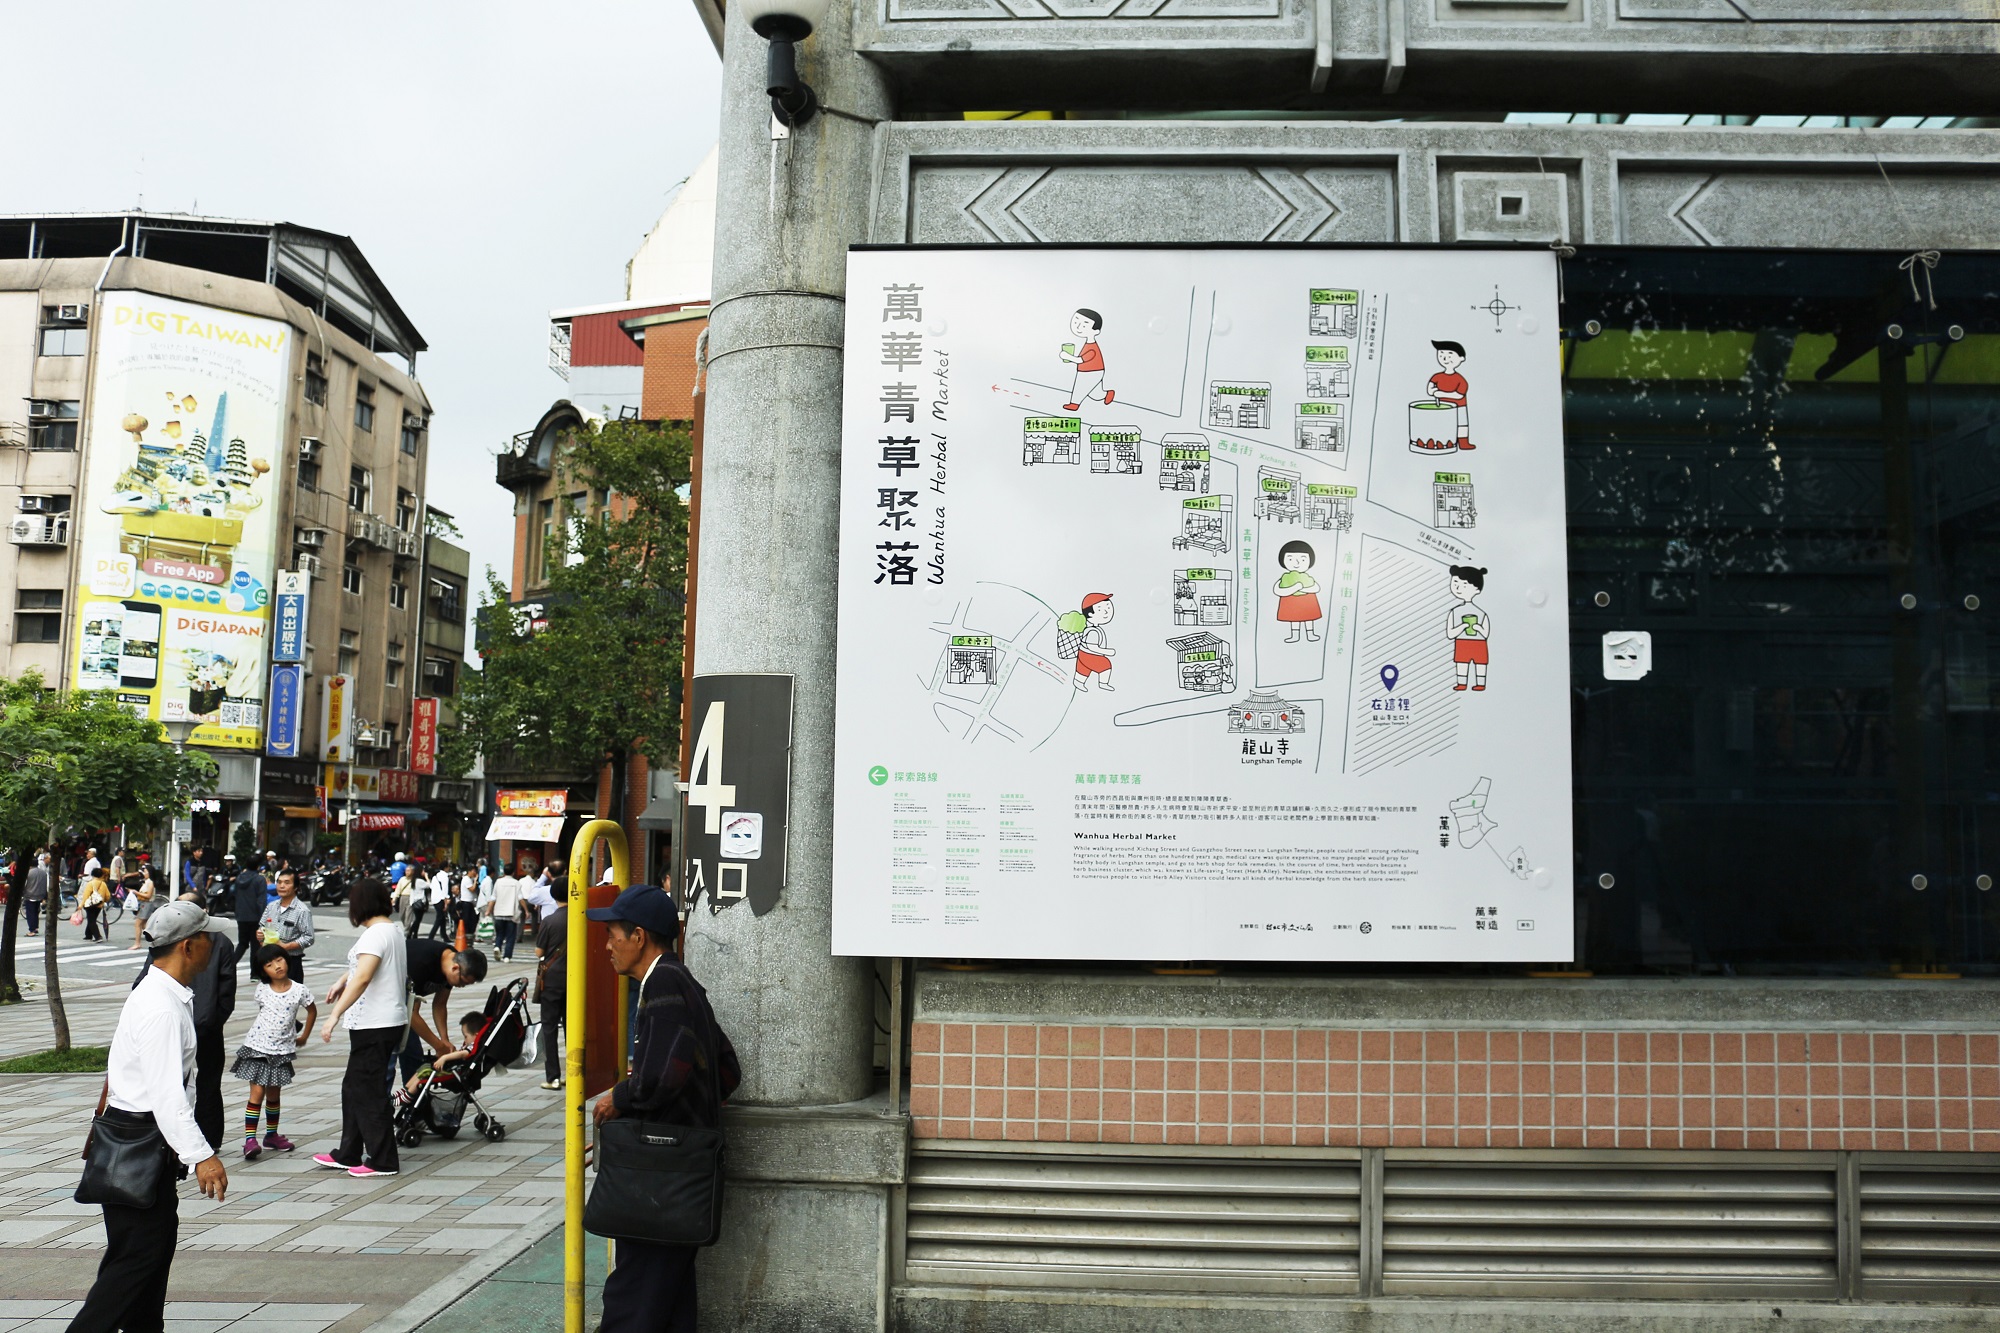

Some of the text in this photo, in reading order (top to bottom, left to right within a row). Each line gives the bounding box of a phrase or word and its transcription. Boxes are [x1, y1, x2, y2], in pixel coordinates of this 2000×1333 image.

[873, 283, 924, 585] 萬華青草聚落
[1217, 439, 1254, 457] 西昌街
[927, 349, 949, 585] Wanhua Herbal Market
[1259, 453, 1287, 467] Xichang
[1242, 528, 1252, 581] 青草巷
[153, 562, 215, 582] Free App
[1336, 605, 1348, 646] Guangzhou
[1371, 698, 1410, 711] 在這裡
[415, 702, 432, 769] 雅哥男飾
[1242, 737, 1290, 756] 龍山寺
[688, 701, 736, 834] 4
[1241, 757, 1303, 766] Lungshan Temple
[894, 772, 938, 783] 探索路線
[1075, 774, 1142, 785] 萬華青草聚落
[1074, 832, 1110, 840] Wanhua
[1145, 833, 1177, 841] Market
[1439, 816, 1450, 848] 萬華
[1073, 852, 1100, 860] fragrance
[1391, 848, 1419, 856] refreshing
[1073, 859, 1094, 867] healthy
[685, 859, 748, 900] 入口
[1401, 869, 1419, 877] appeal
[1476, 907, 1498, 916] 萬華
[1476, 920, 1498, 931] 製造
